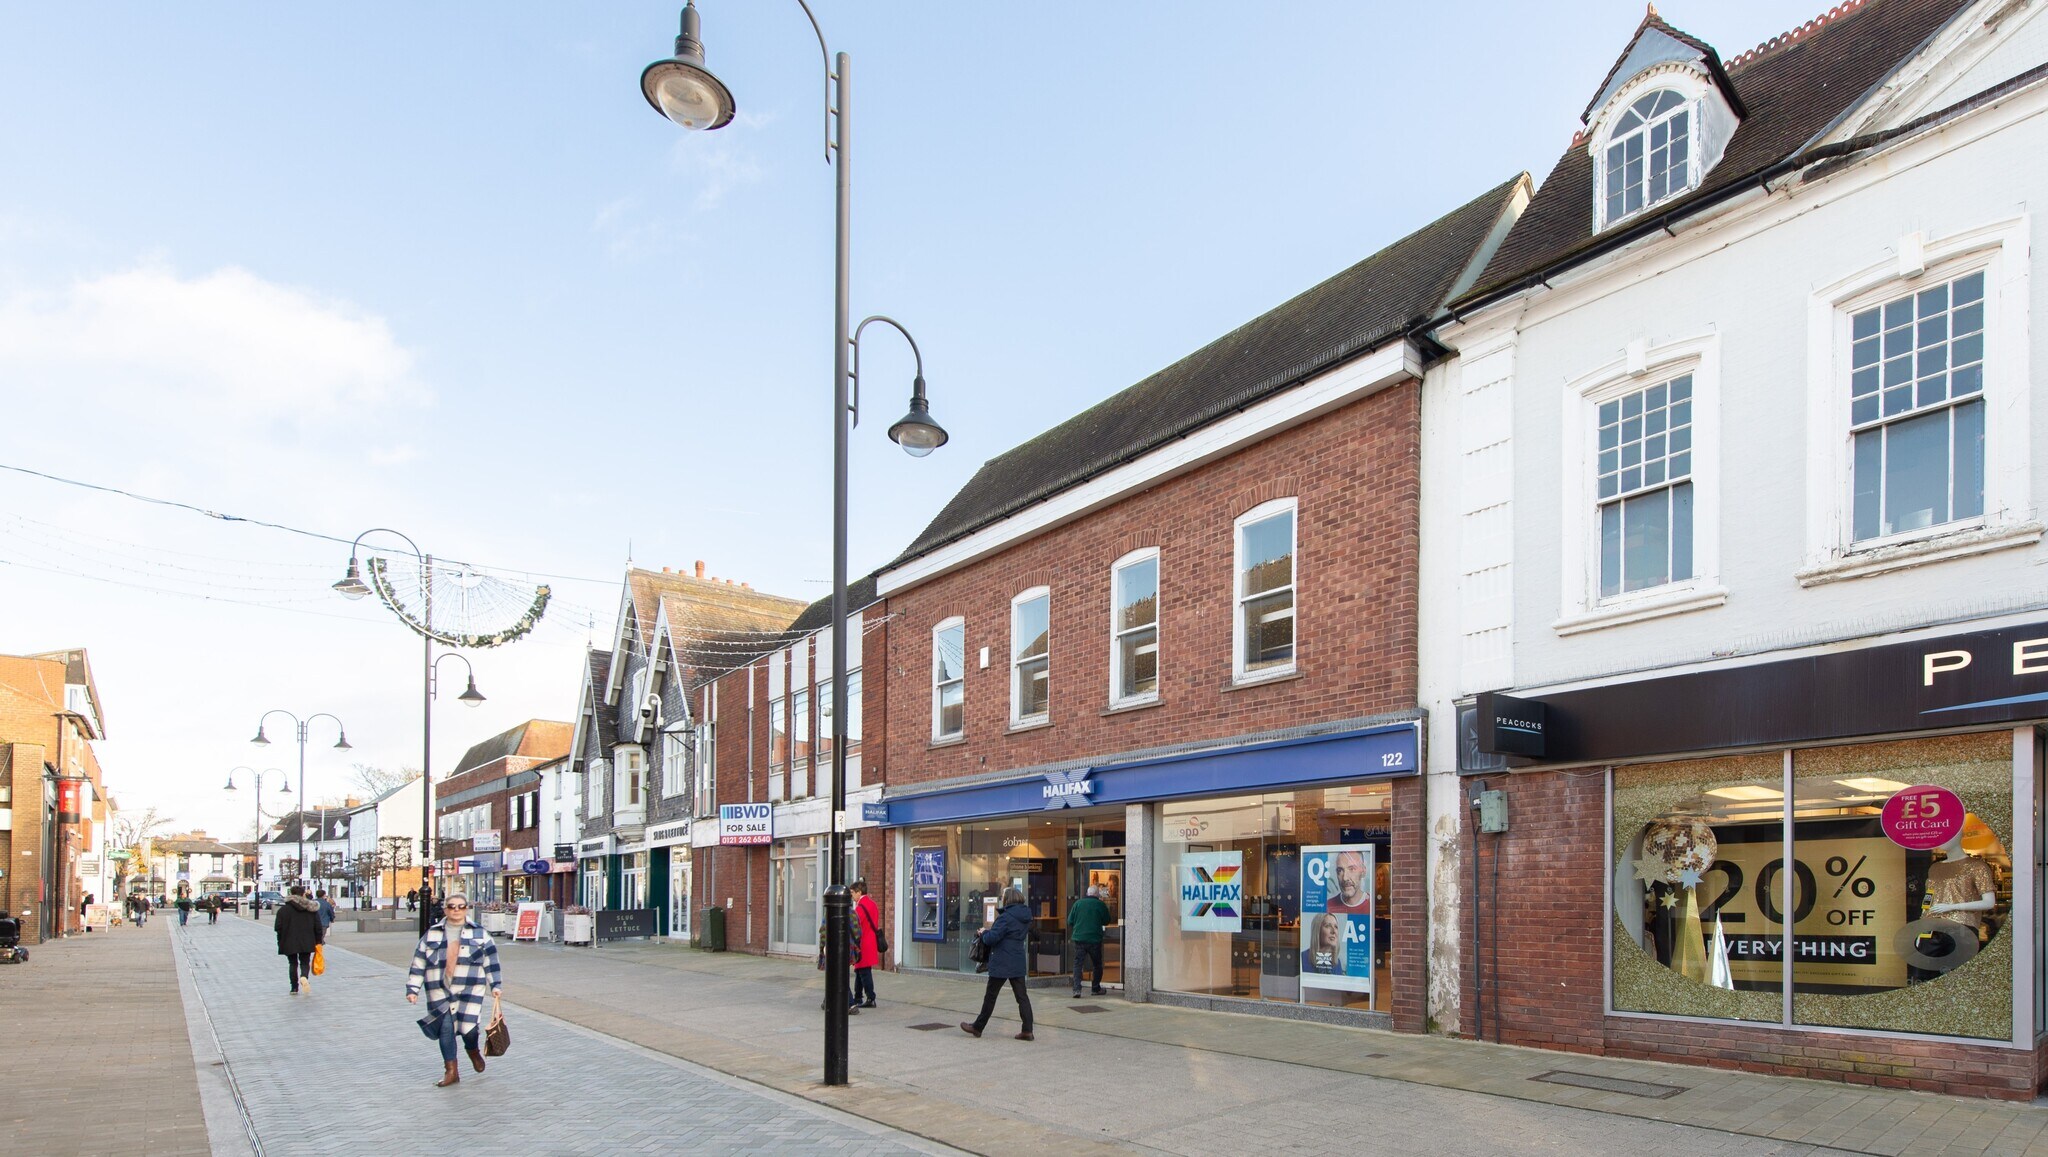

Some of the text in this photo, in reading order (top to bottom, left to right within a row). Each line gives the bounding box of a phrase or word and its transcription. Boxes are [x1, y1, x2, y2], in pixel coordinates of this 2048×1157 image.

[1496, 716, 1542, 730] PEACOCKS
[1381, 752, 1403, 767] 122
[1043, 780, 1091, 798] HALIFAX
[1901, 793, 1941, 819] £5
[726, 823, 766, 833] FOR SALE
[1895, 818, 1950, 830] Gift Card
[722, 835, 770, 844] 0121 262 6540
[1307, 857, 1330, 886] Q:
[1182, 884, 1241, 901] HALIFAX
[1826, 909, 1876, 926] OFF
[609, 925, 640, 933] LETTUCE
[1342, 920, 1366, 944] A:
